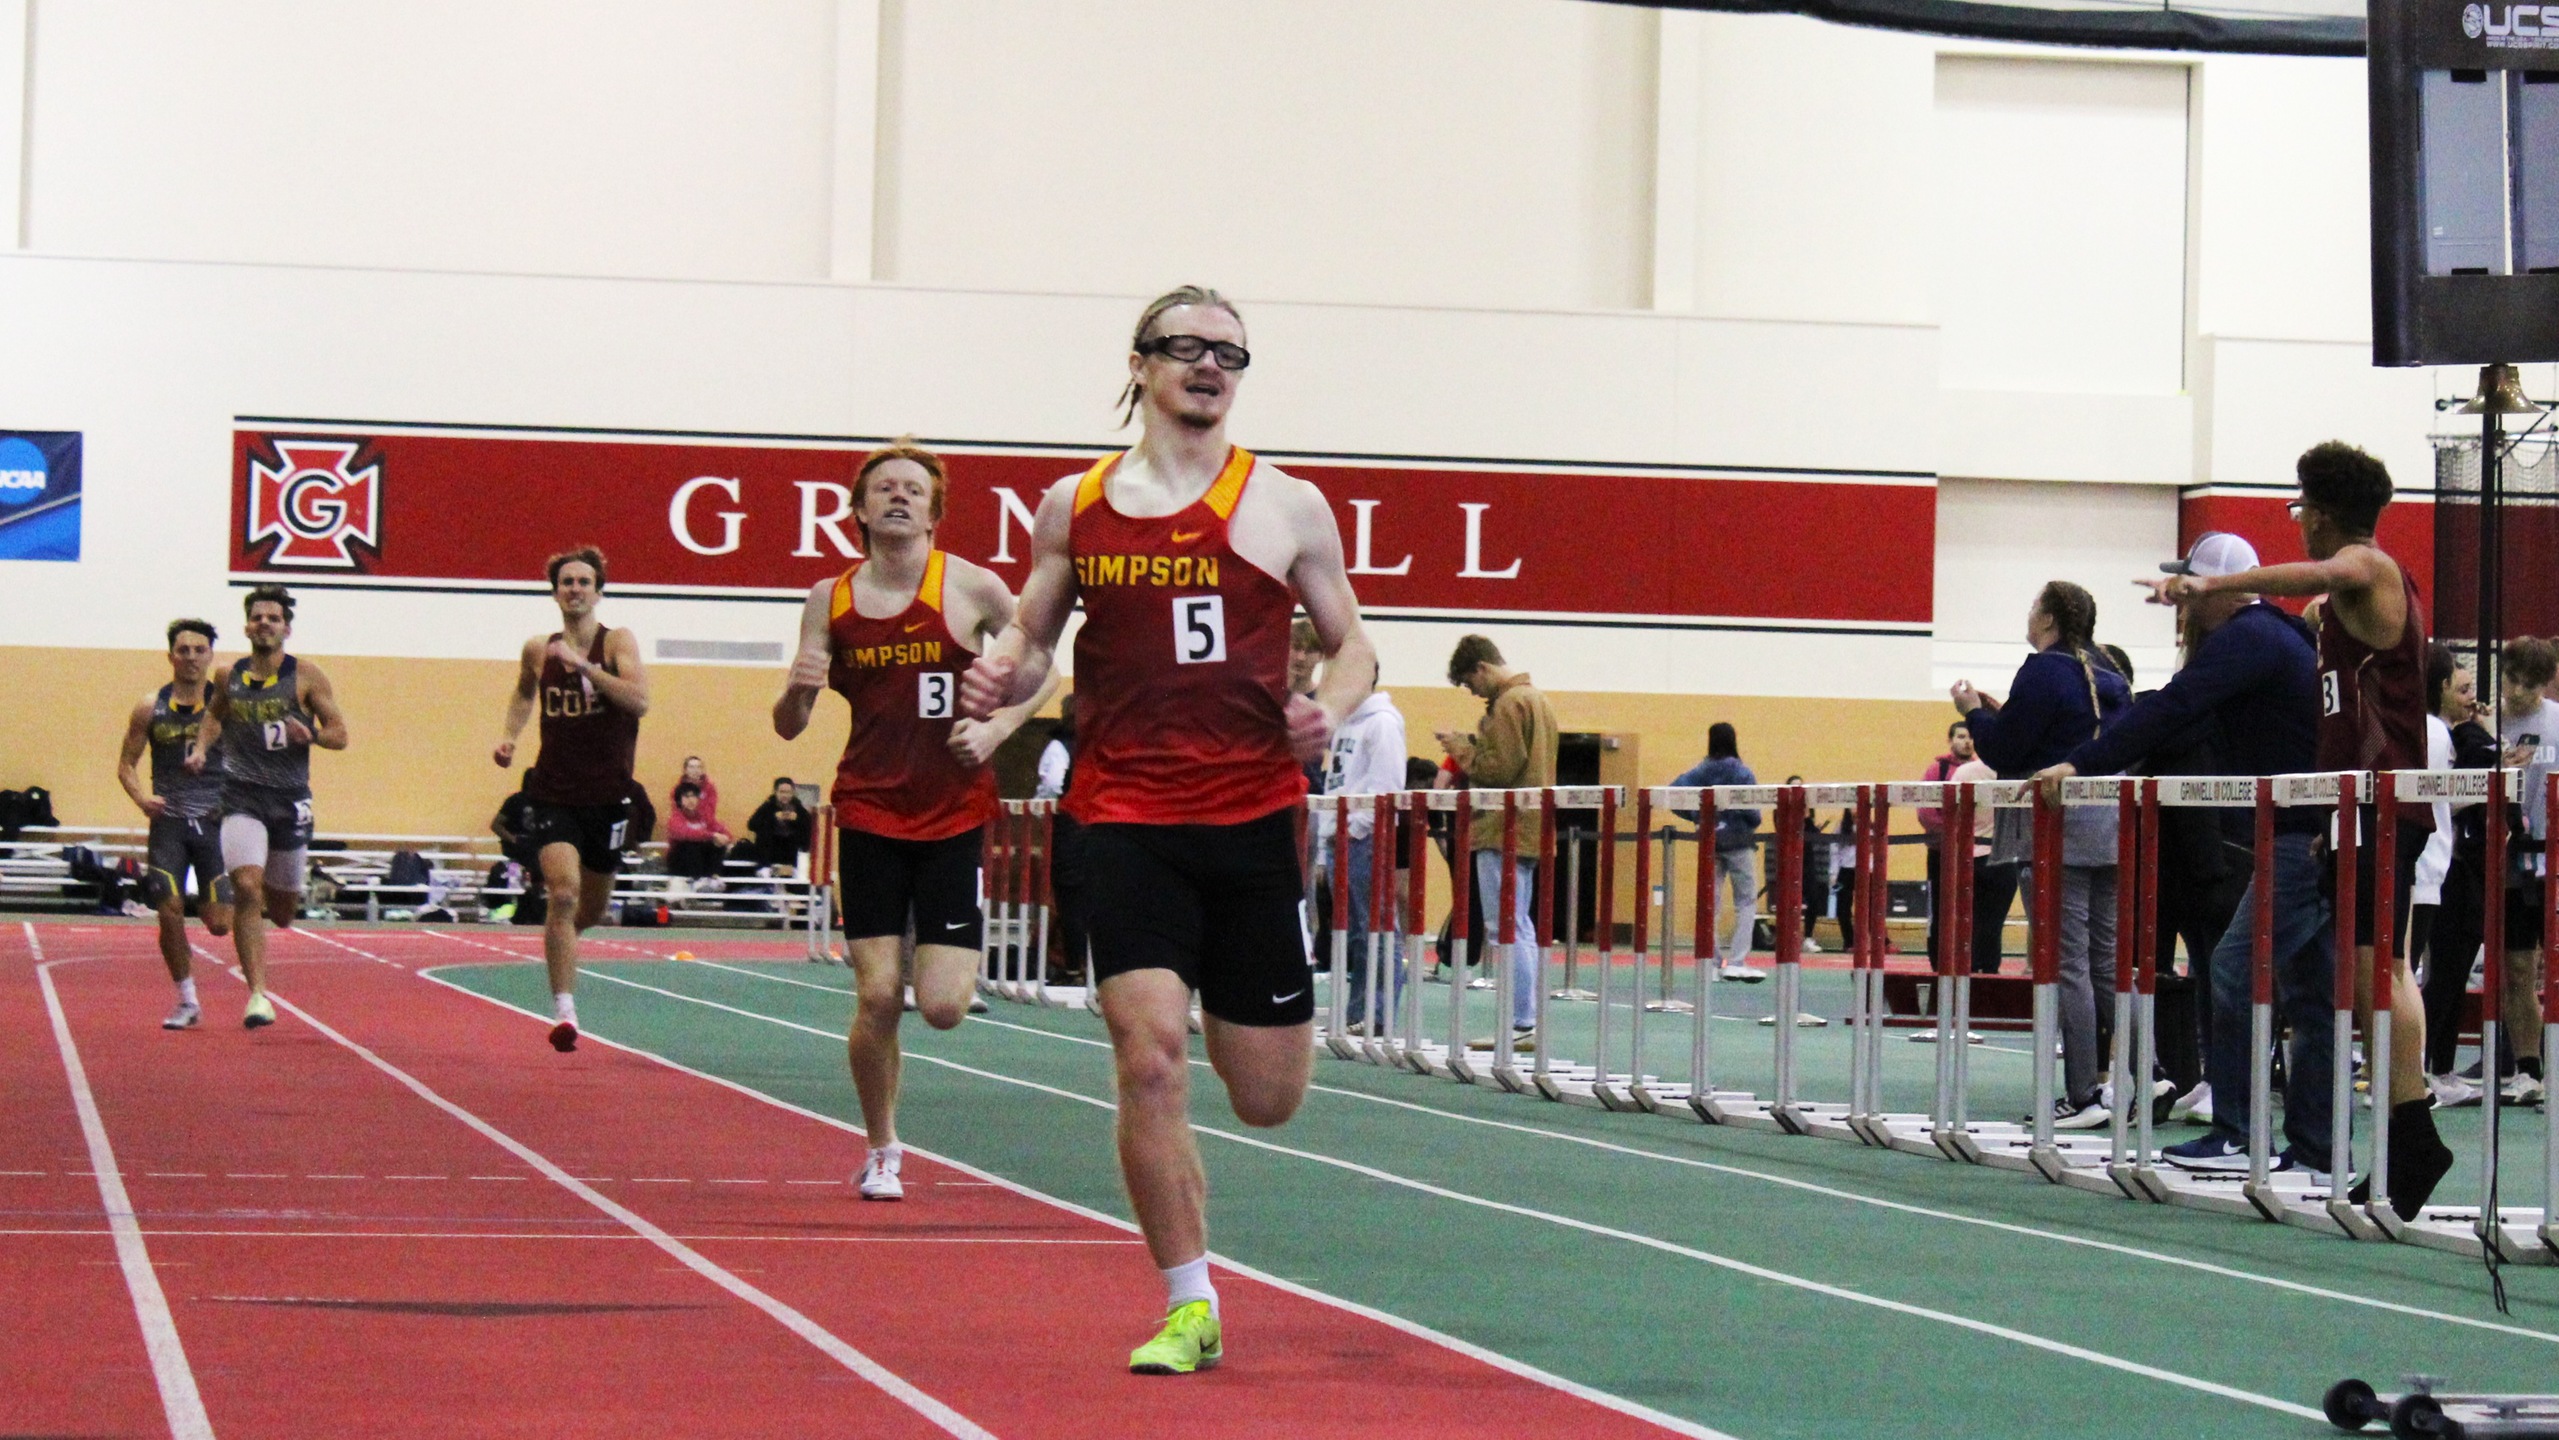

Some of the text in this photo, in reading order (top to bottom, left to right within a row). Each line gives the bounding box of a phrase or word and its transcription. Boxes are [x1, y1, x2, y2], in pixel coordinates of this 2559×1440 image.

[278, 468, 347, 540] G
[669, 475, 1523, 580] GRNLL
[1187, 602, 1215, 660] 5
[926, 675, 946, 717] 3
[2323, 675, 2334, 714] 3
[270, 723, 284, 748] 2
